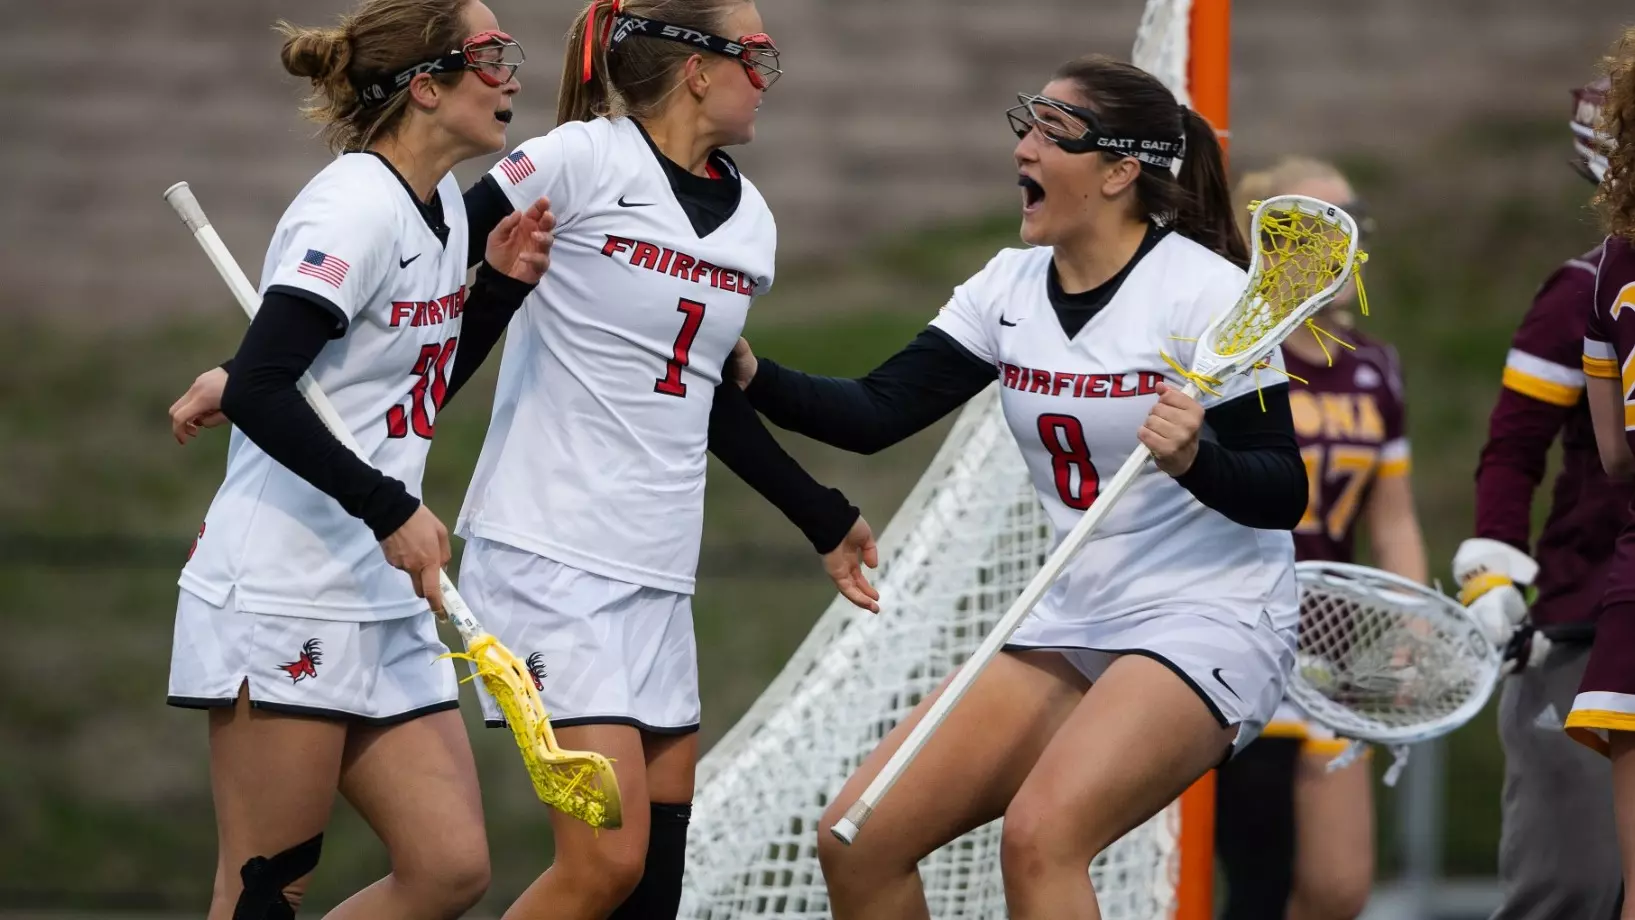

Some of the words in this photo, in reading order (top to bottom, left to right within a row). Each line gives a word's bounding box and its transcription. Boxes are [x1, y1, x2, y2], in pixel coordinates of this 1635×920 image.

[660, 24, 711, 46] STX
[395, 58, 444, 87] STX
[1097, 137, 1135, 148] GAIT
[1141, 140, 1172, 151] GAIT
[653, 297, 707, 398] 1
[999, 360, 1164, 398] AIRFIELD
[1289, 389, 1386, 441] ONA
[1036, 412, 1100, 511] 8
